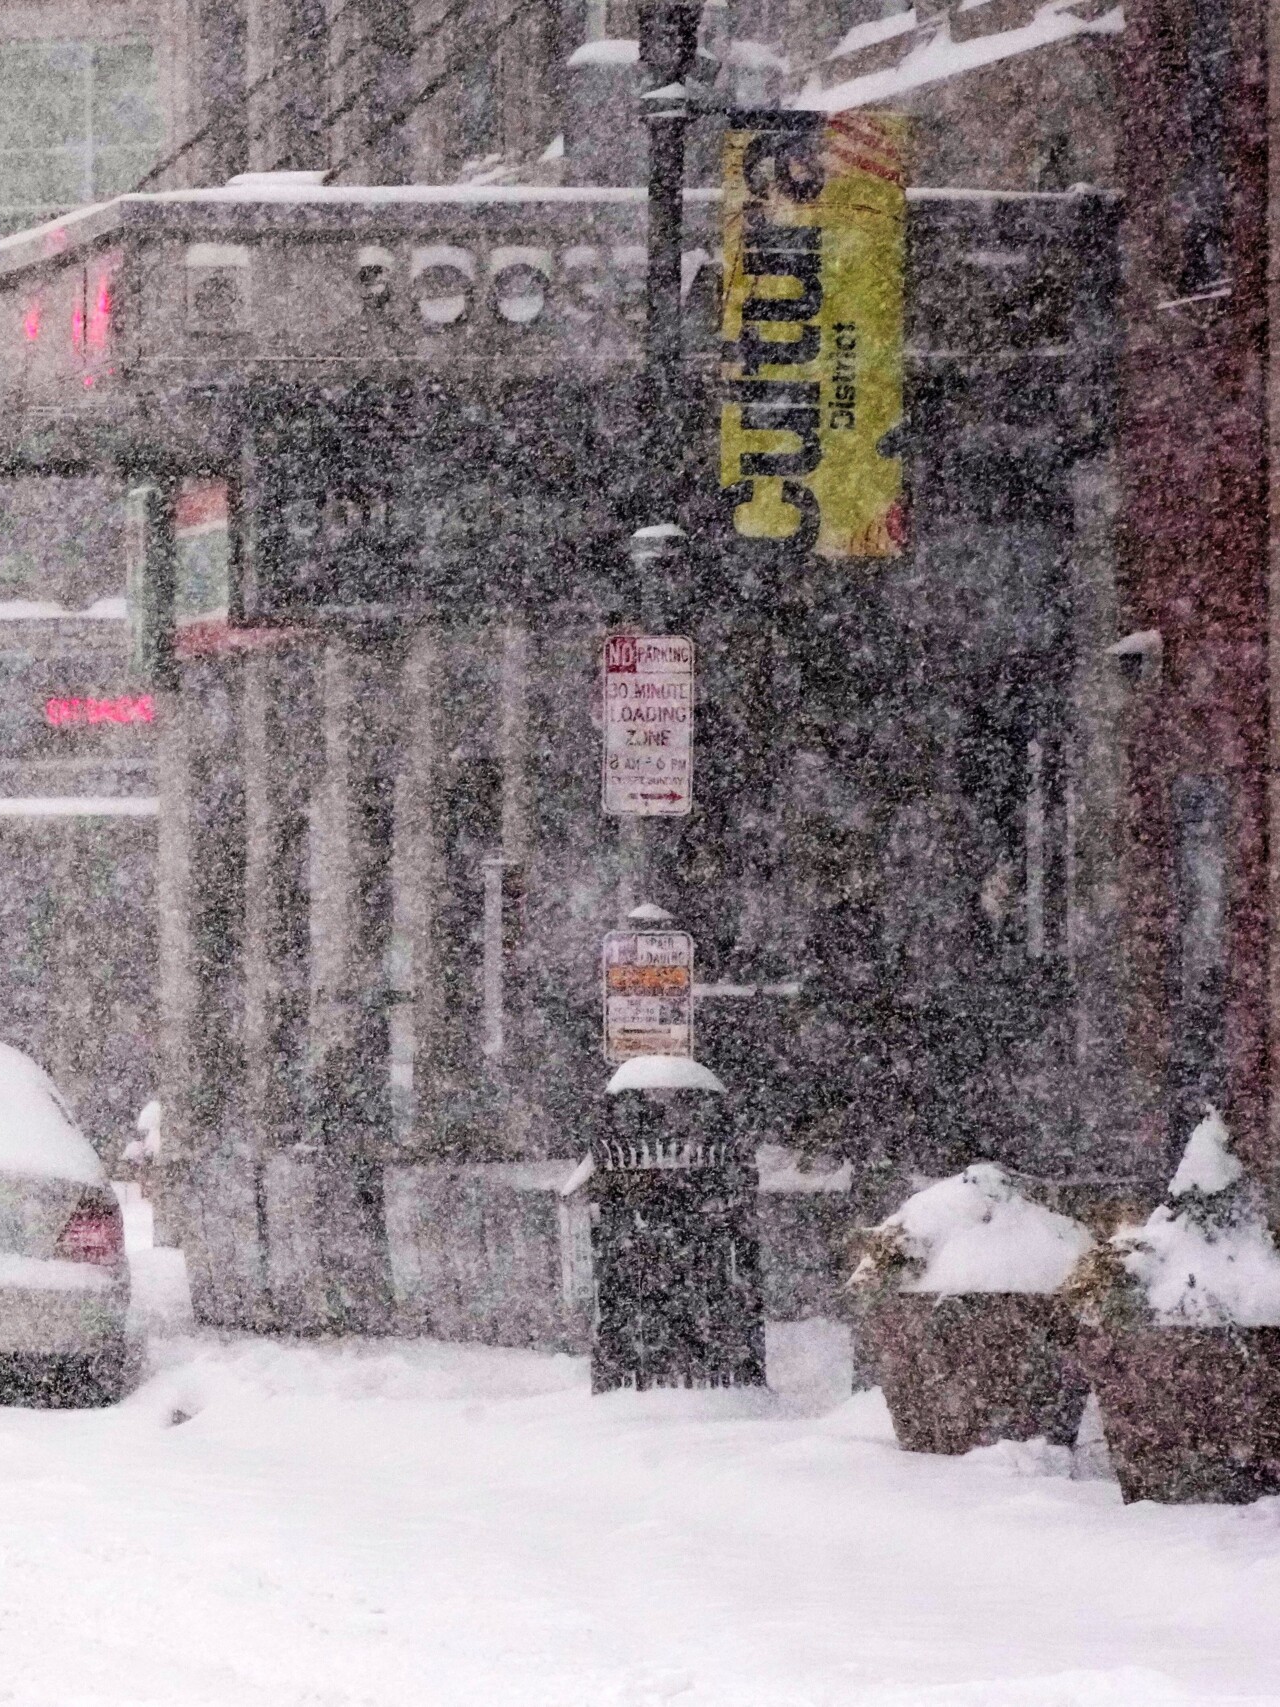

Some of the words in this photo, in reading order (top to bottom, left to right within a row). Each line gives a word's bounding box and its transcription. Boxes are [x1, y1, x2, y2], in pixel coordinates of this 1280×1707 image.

[721, 110, 824, 554] Cultural
[828, 321, 857, 431] District
[610, 643, 634, 665] NO
[637, 646, 689, 662] PARKING
[608, 683, 629, 698] 30
[635, 683, 688, 699] MINUTE
[610, 706, 687, 722] LOADING
[626, 730, 671, 746] ZONE
